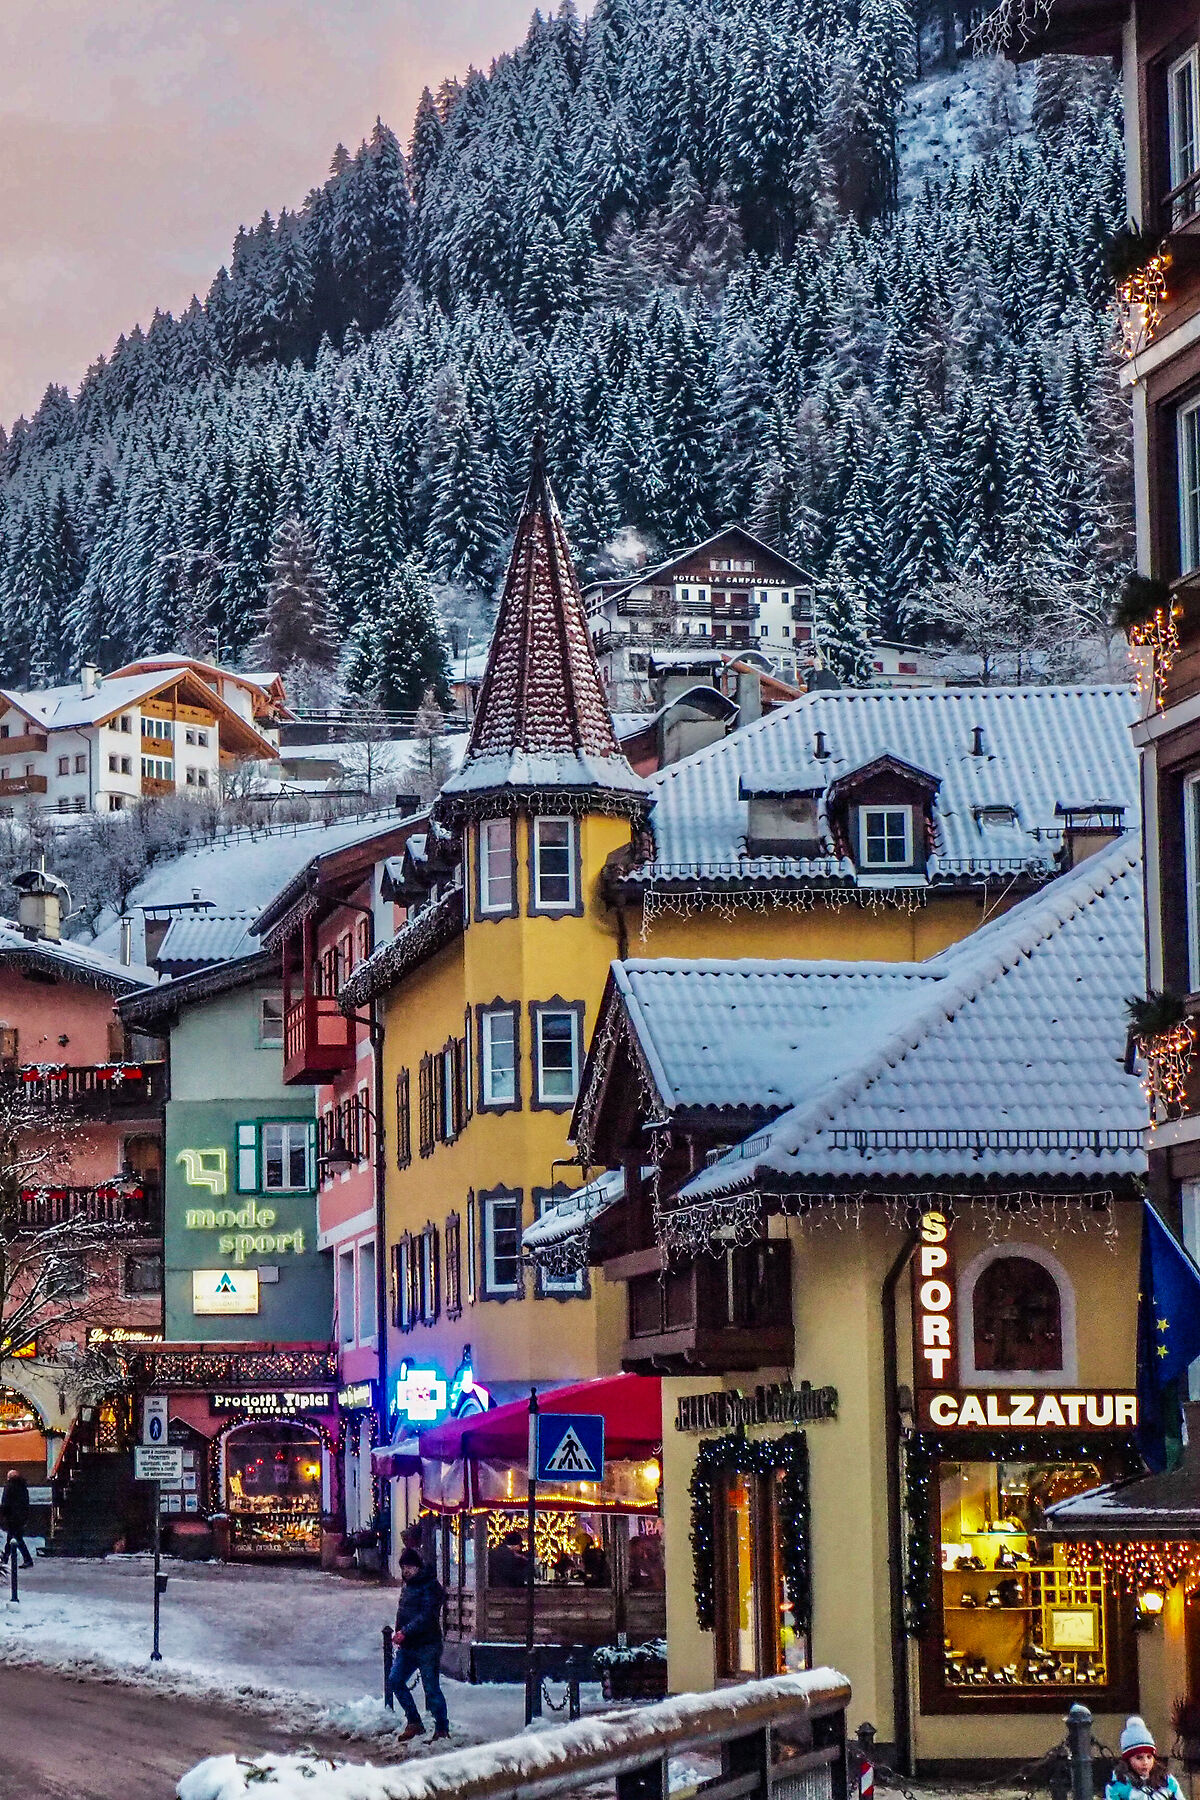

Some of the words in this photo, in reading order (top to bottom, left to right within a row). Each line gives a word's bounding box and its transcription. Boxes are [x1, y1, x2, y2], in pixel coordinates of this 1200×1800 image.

[726, 577, 786, 585] CAMPAGNOLA
[185, 1199, 275, 1229] mode
[219, 1228, 305, 1264] sport
[920, 1211, 951, 1379] SPORT
[88, 1328, 109, 1342] La
[214, 1394, 277, 1407] Prodotti
[283, 1393, 329, 1409] Tipici
[247, 1406, 296, 1414] Enoteca
[929, 1395, 1137, 1426] CALZATUR
